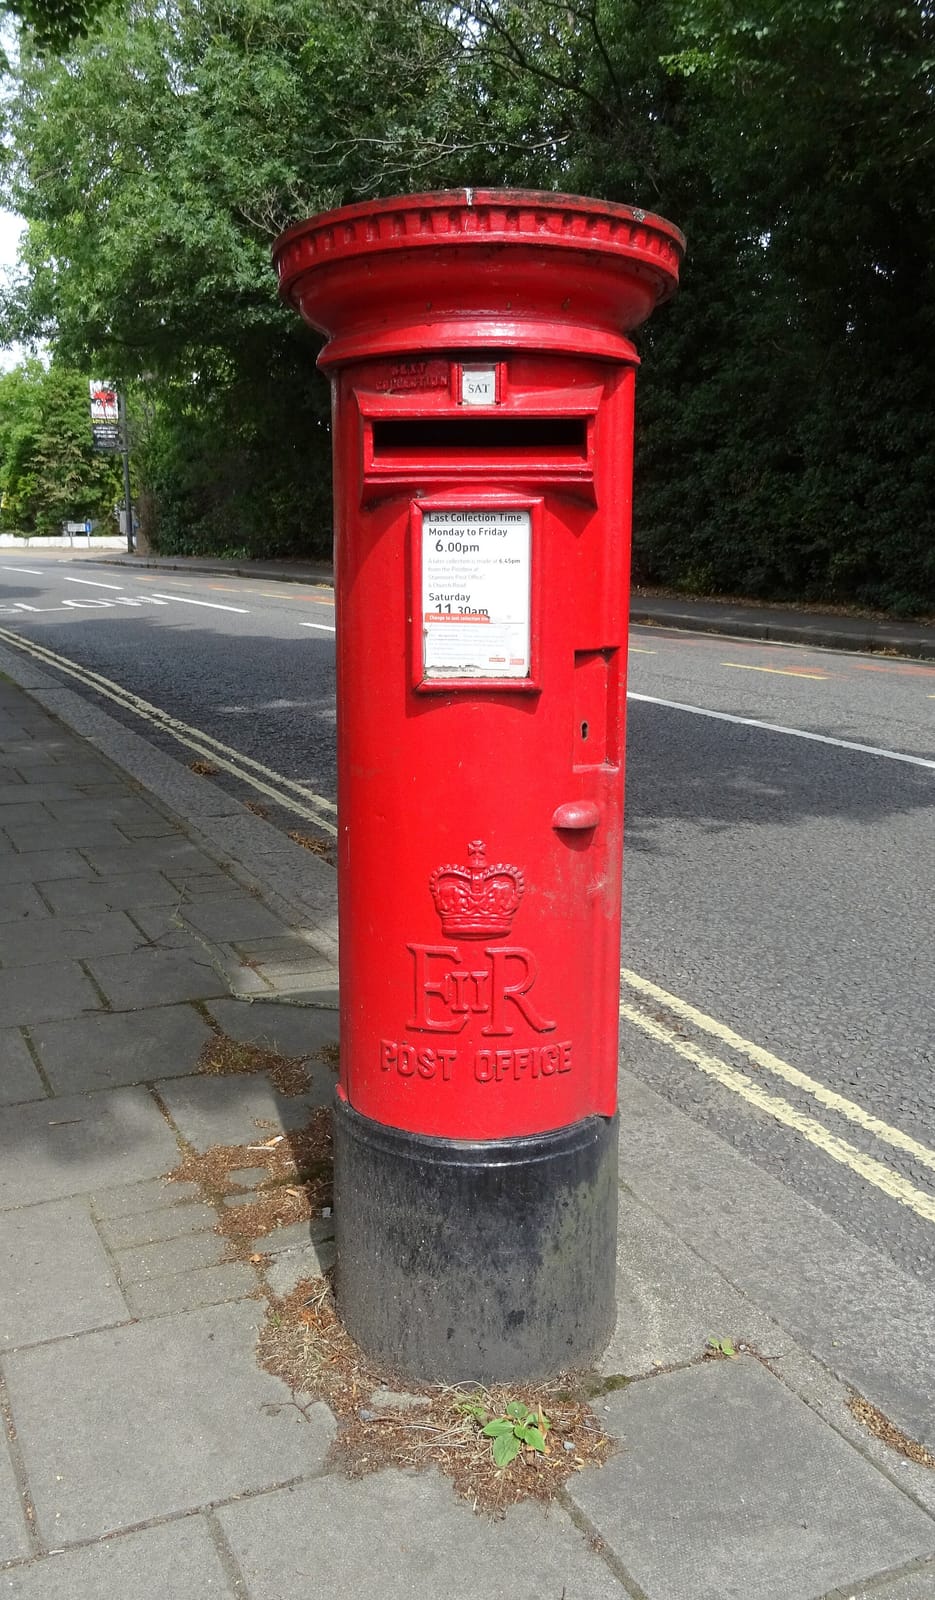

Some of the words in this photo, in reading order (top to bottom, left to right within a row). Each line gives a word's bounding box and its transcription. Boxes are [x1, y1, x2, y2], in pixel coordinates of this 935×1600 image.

[467, 383, 490, 393] SAT
[428, 513, 449, 522] Last
[450, 513, 496, 522] Collection
[498, 513, 522, 522] Time
[428, 527, 465, 537] Monday
[467, 528, 476, 536] to
[478, 527, 508, 537] Friday
[435, 539, 480, 554] 6.00pm
[428, 593, 471, 602] Saturday
[380, 1038, 457, 1081] POST
[474, 1040, 573, 1083] OFFICE
